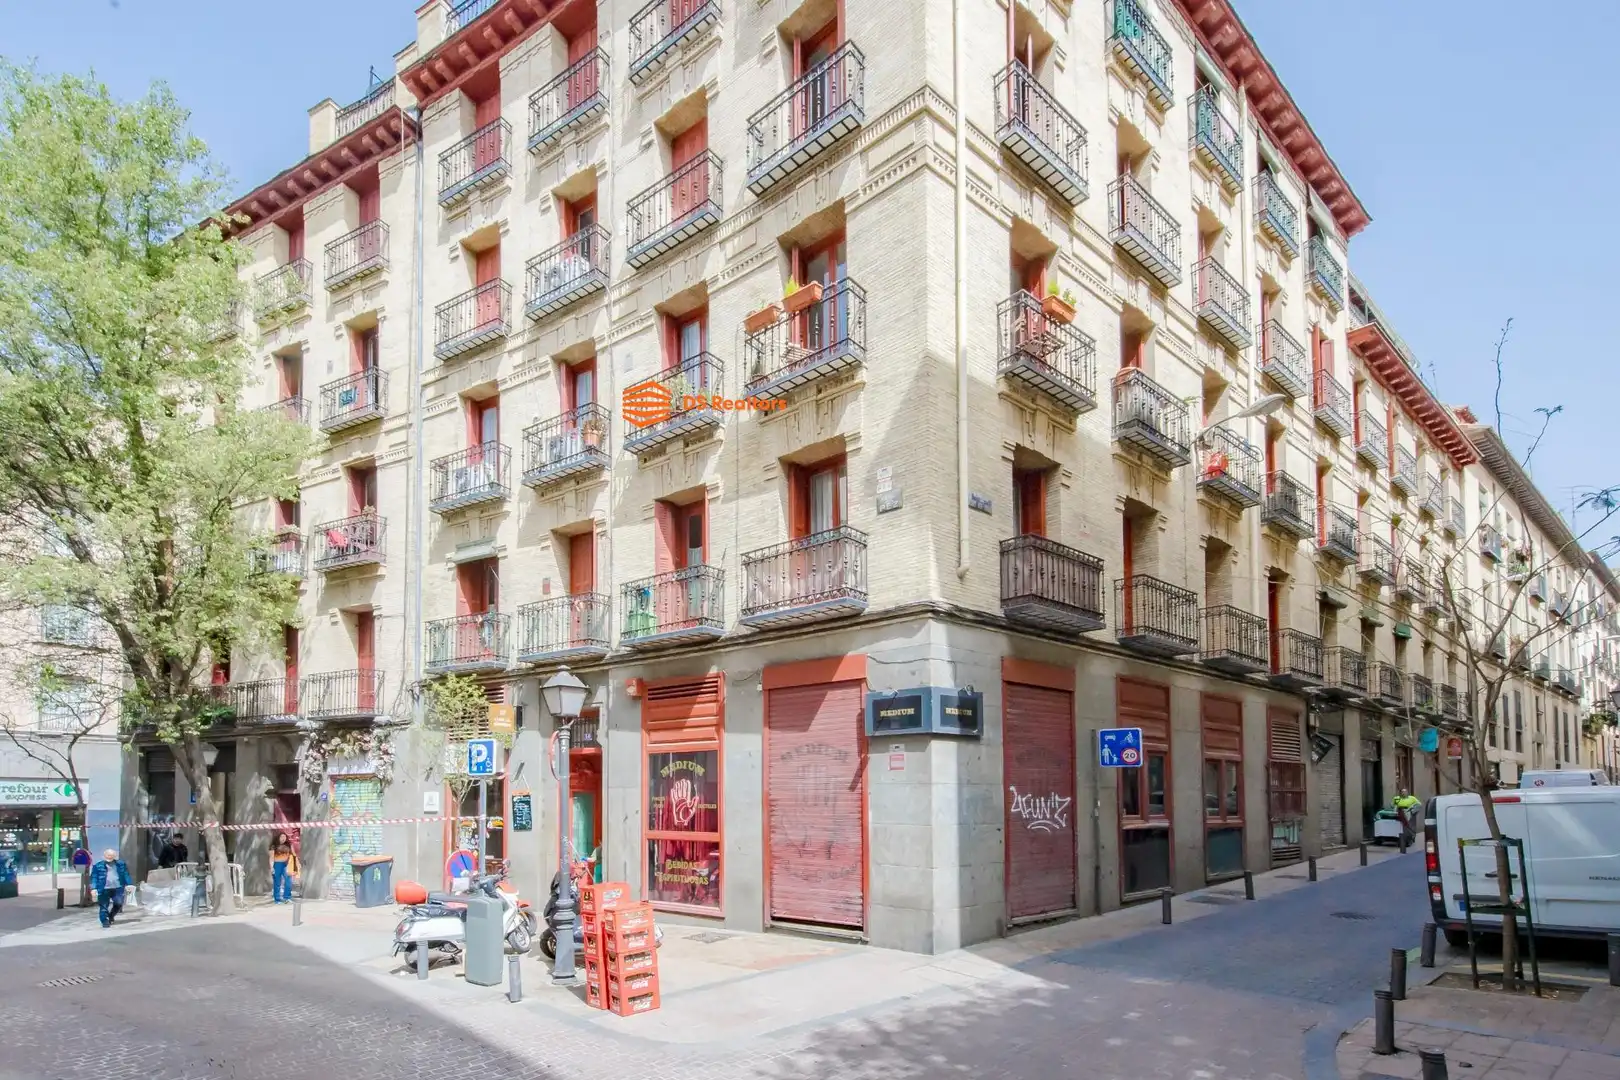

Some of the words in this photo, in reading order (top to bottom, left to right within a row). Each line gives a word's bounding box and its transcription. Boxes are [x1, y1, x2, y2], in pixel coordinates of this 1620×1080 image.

[880, 708, 915, 717] MEDIUM
[945, 707, 972, 716] MEDIUM
[471, 743, 487, 771] P
[660, 761, 705, 777] MEDIUM
[5, 793, 48, 801] express
[666, 859, 697, 870] BEBIDAS
